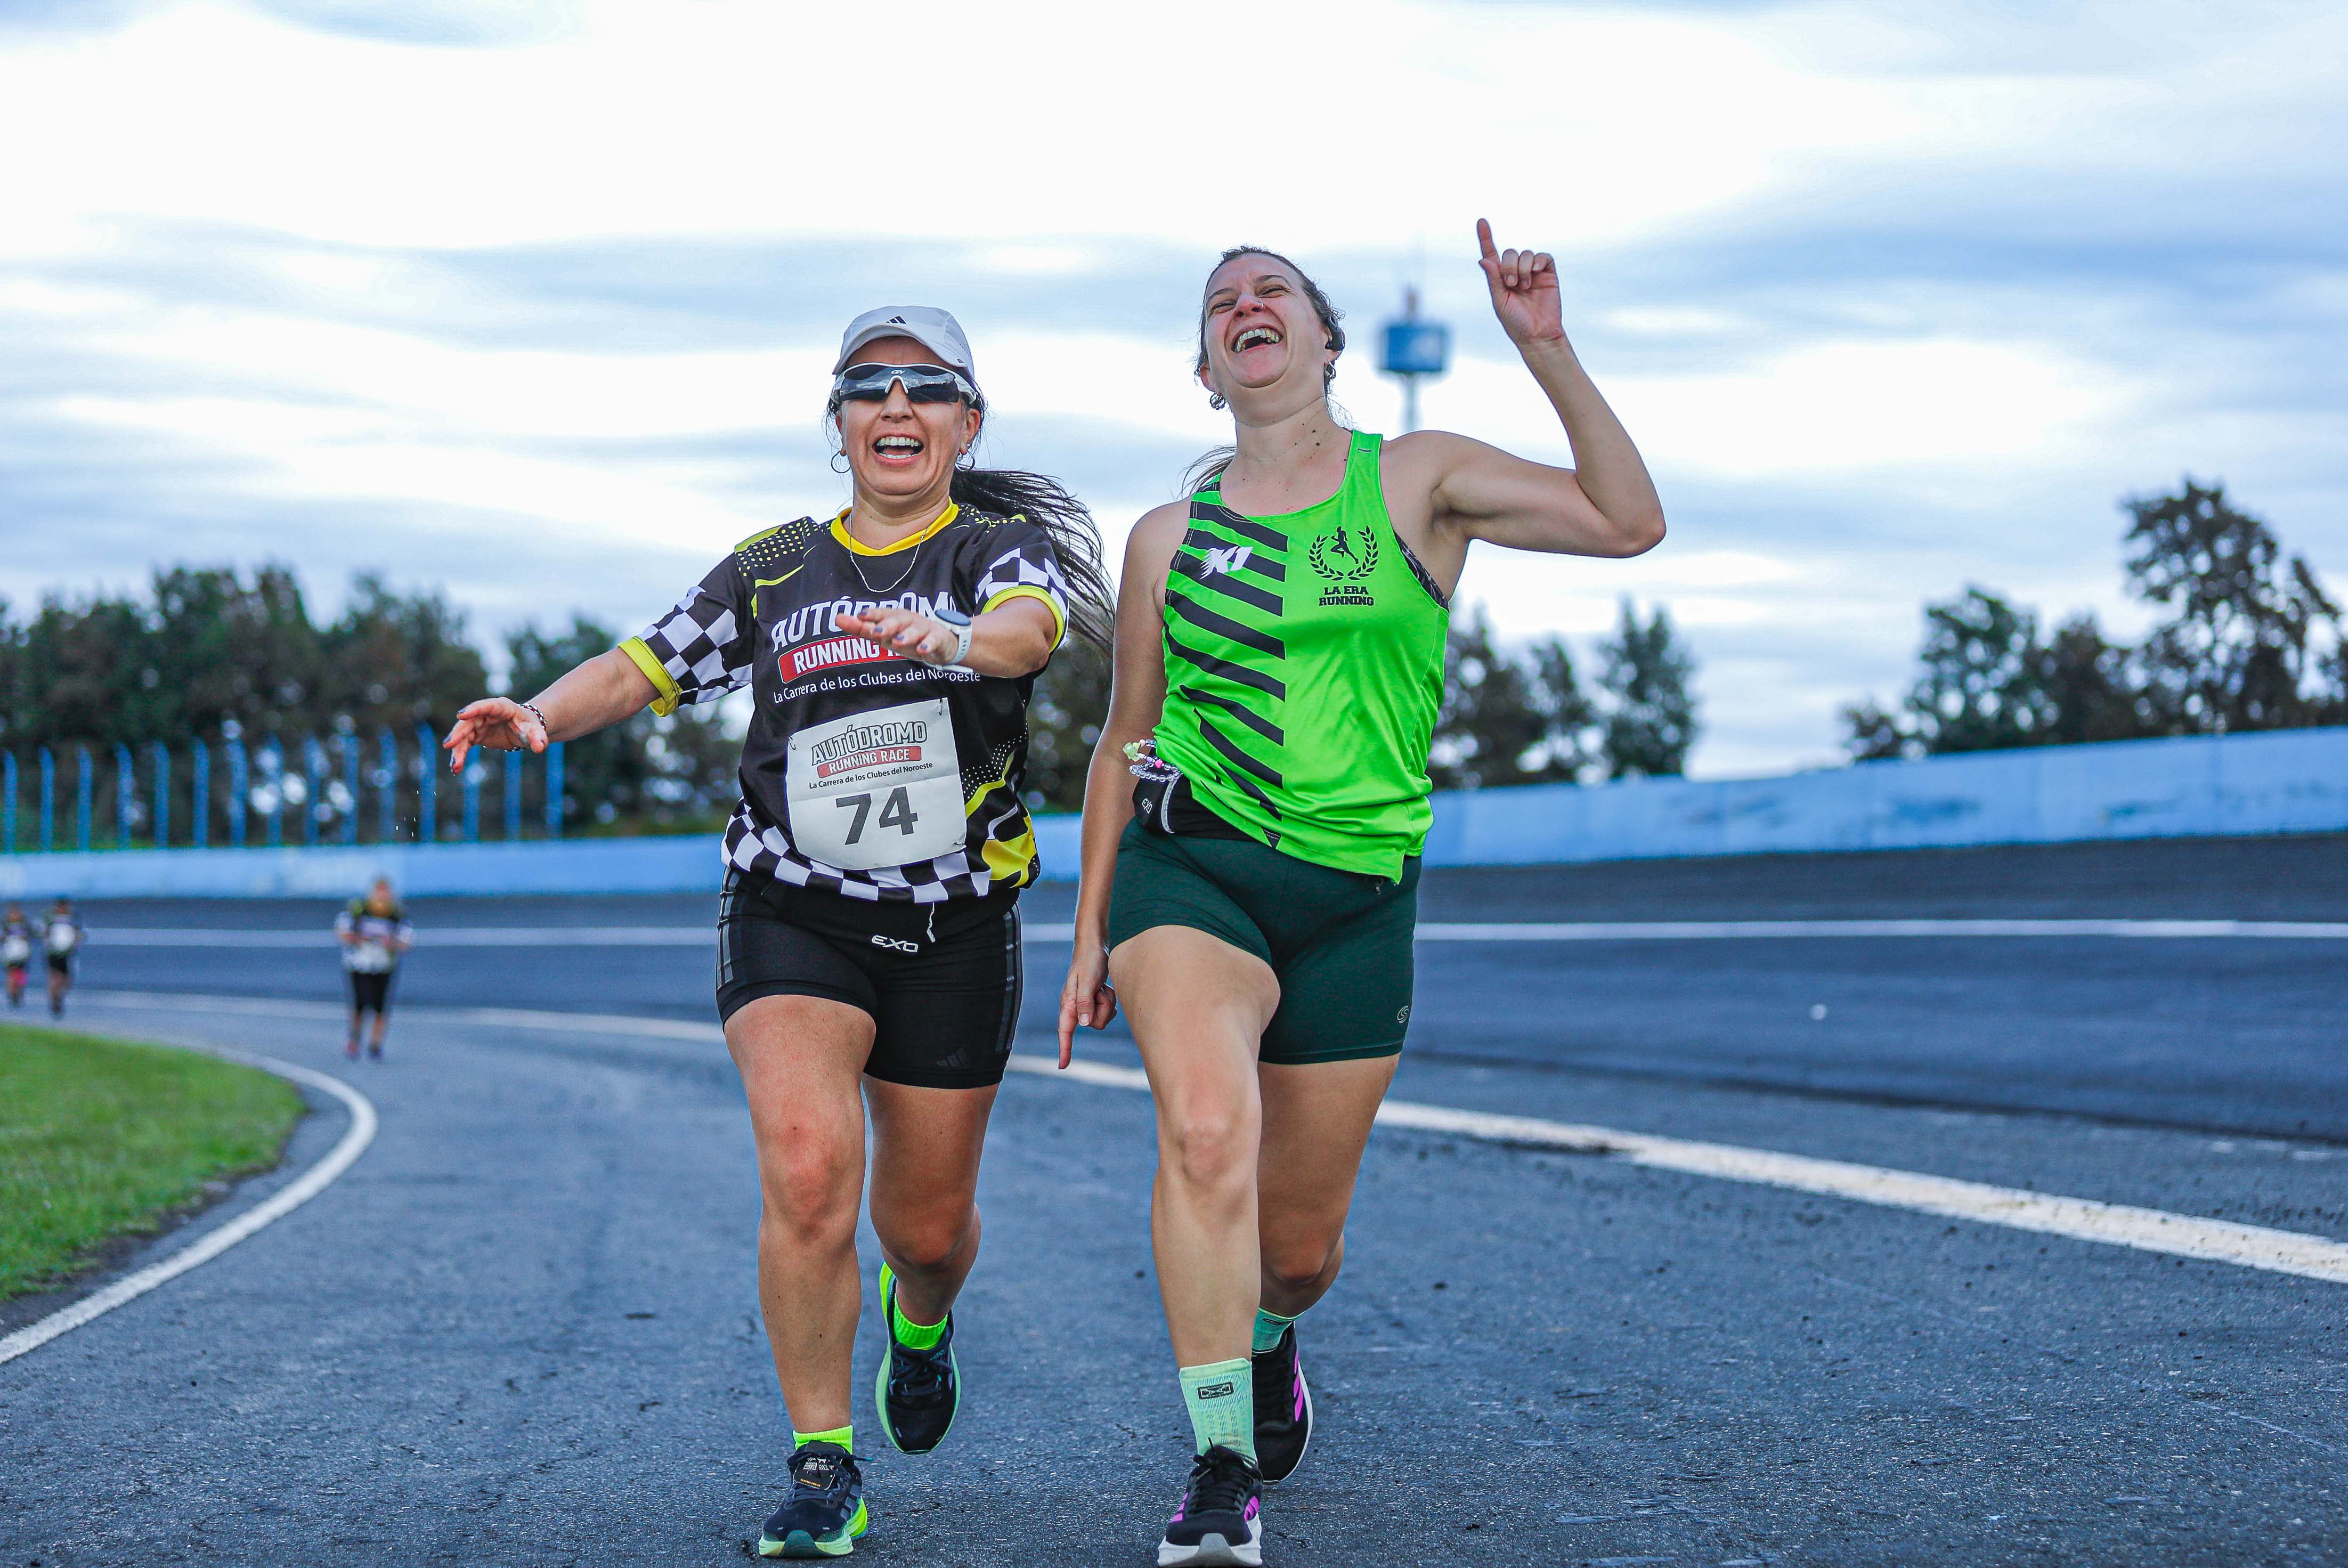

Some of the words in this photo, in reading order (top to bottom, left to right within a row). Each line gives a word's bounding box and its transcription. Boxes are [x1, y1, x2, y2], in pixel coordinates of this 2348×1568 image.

[1319, 596, 1374, 606] RUNNING
[1324, 586, 1341, 595] LA
[1344, 586, 1369, 595] ERA
[771, 591, 957, 653] AUTÓOM
[792, 638, 881, 675] RUNNING
[773, 692, 783, 704] La
[783, 684, 817, 700] Carrera
[820, 678, 836, 690] de
[839, 676, 857, 688] los
[859, 672, 903, 686] Clubes
[906, 669, 925, 681] del
[928, 669, 980, 682] Noroeste
[811, 721, 928, 766] AUTÓDROMO
[818, 778, 844, 787] Carrera
[845, 774, 854, 783] de
[855, 772, 866, 781] los
[866, 768, 890, 779] Clubes
[891, 766, 902, 775] del
[903, 762, 933, 773] Noroeste
[828, 752, 878, 774] RUNNING
[880, 748, 910, 762] RACE
[835, 786, 919, 846] 74
[871, 935, 919, 953] EXO
